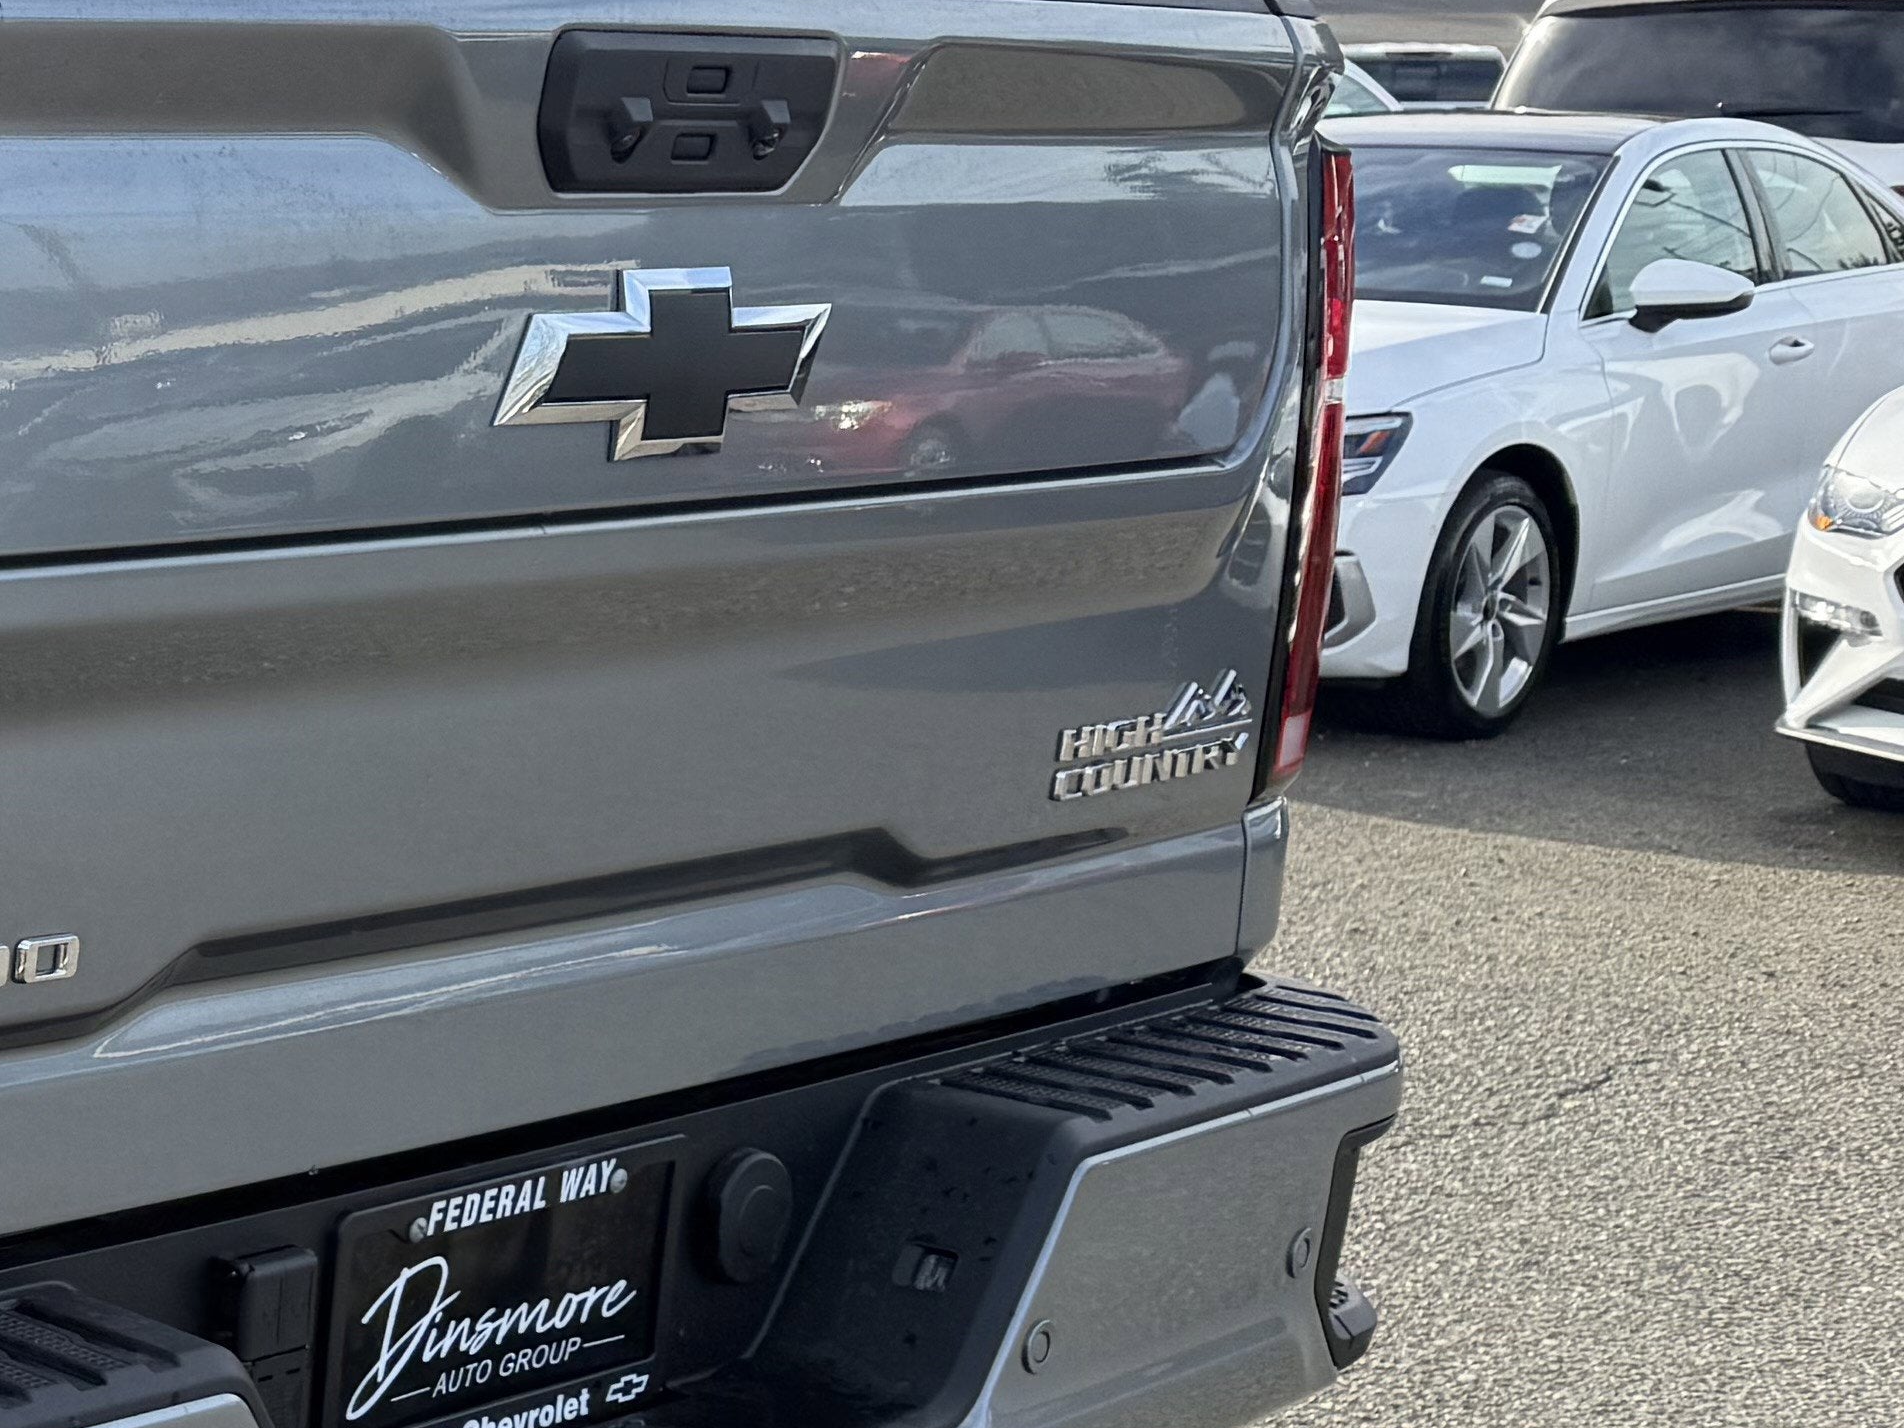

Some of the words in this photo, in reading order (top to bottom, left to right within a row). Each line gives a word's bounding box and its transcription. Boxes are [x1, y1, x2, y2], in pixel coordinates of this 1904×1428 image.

[1049, 732, 1250, 802] COUNTRY
[1056, 711, 1168, 762] HIGH
[426, 1176, 547, 1236] FEDERAL
[559, 1158, 617, 1203] WAY
[345, 1255, 638, 1422] Dinsmore
[432, 1358, 492, 1398] AUTO
[498, 1336, 582, 1377] GROUP
